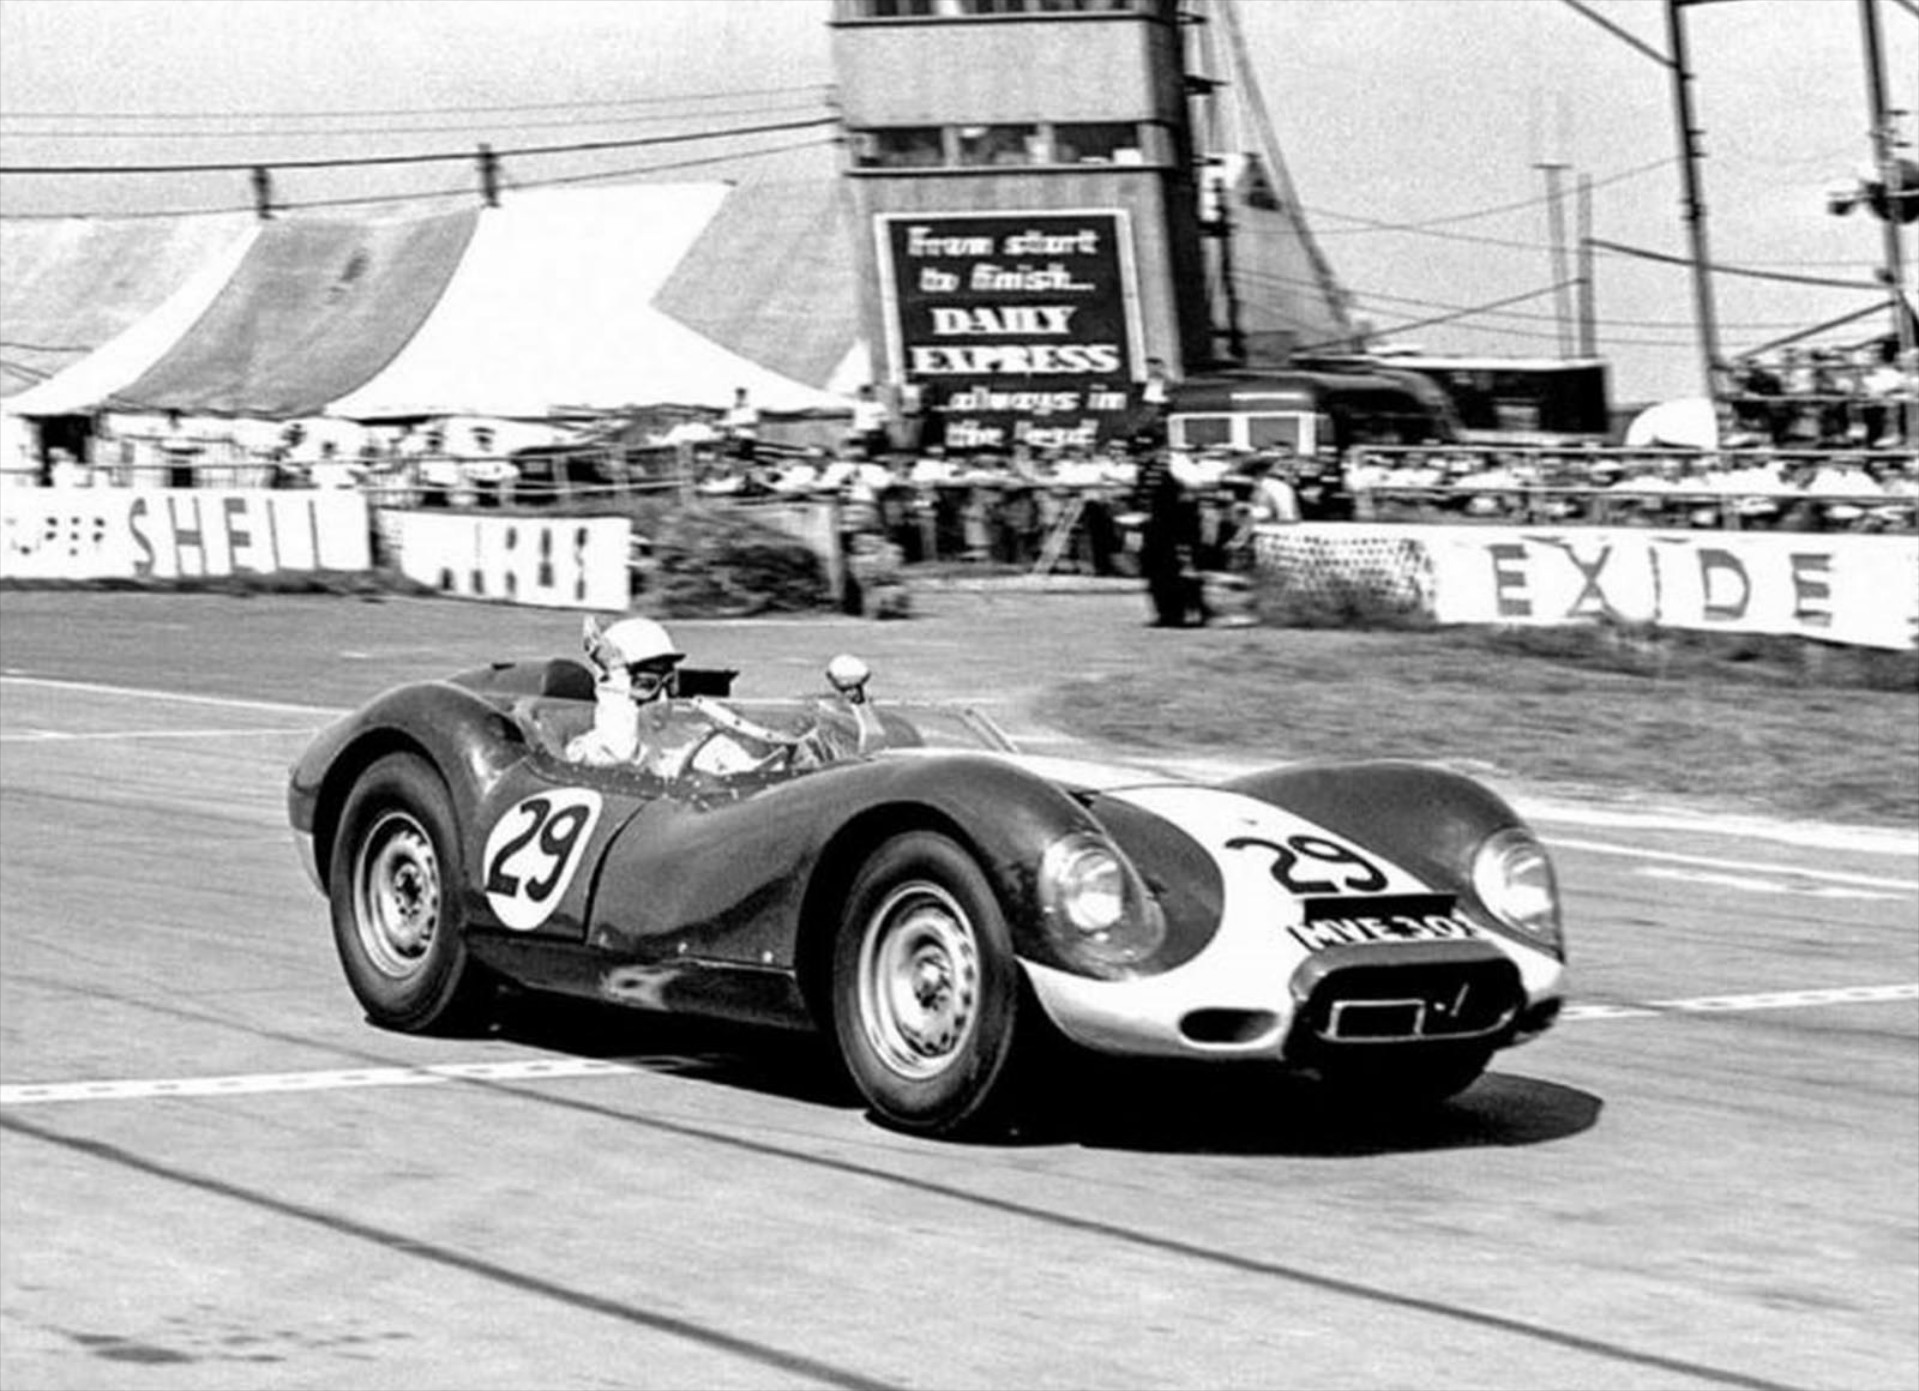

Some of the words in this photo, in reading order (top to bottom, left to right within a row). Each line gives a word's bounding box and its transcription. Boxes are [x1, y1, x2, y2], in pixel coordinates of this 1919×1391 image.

[907, 226, 994, 256] From
[1003, 229, 1099, 255] start
[928, 305, 1078, 335] DAILY
[908, 343, 1121, 375] EXPRESS
[1485, 537, 1832, 628] EXIDE
[484, 798, 590, 903] 29
[1224, 835, 1389, 894] 29
